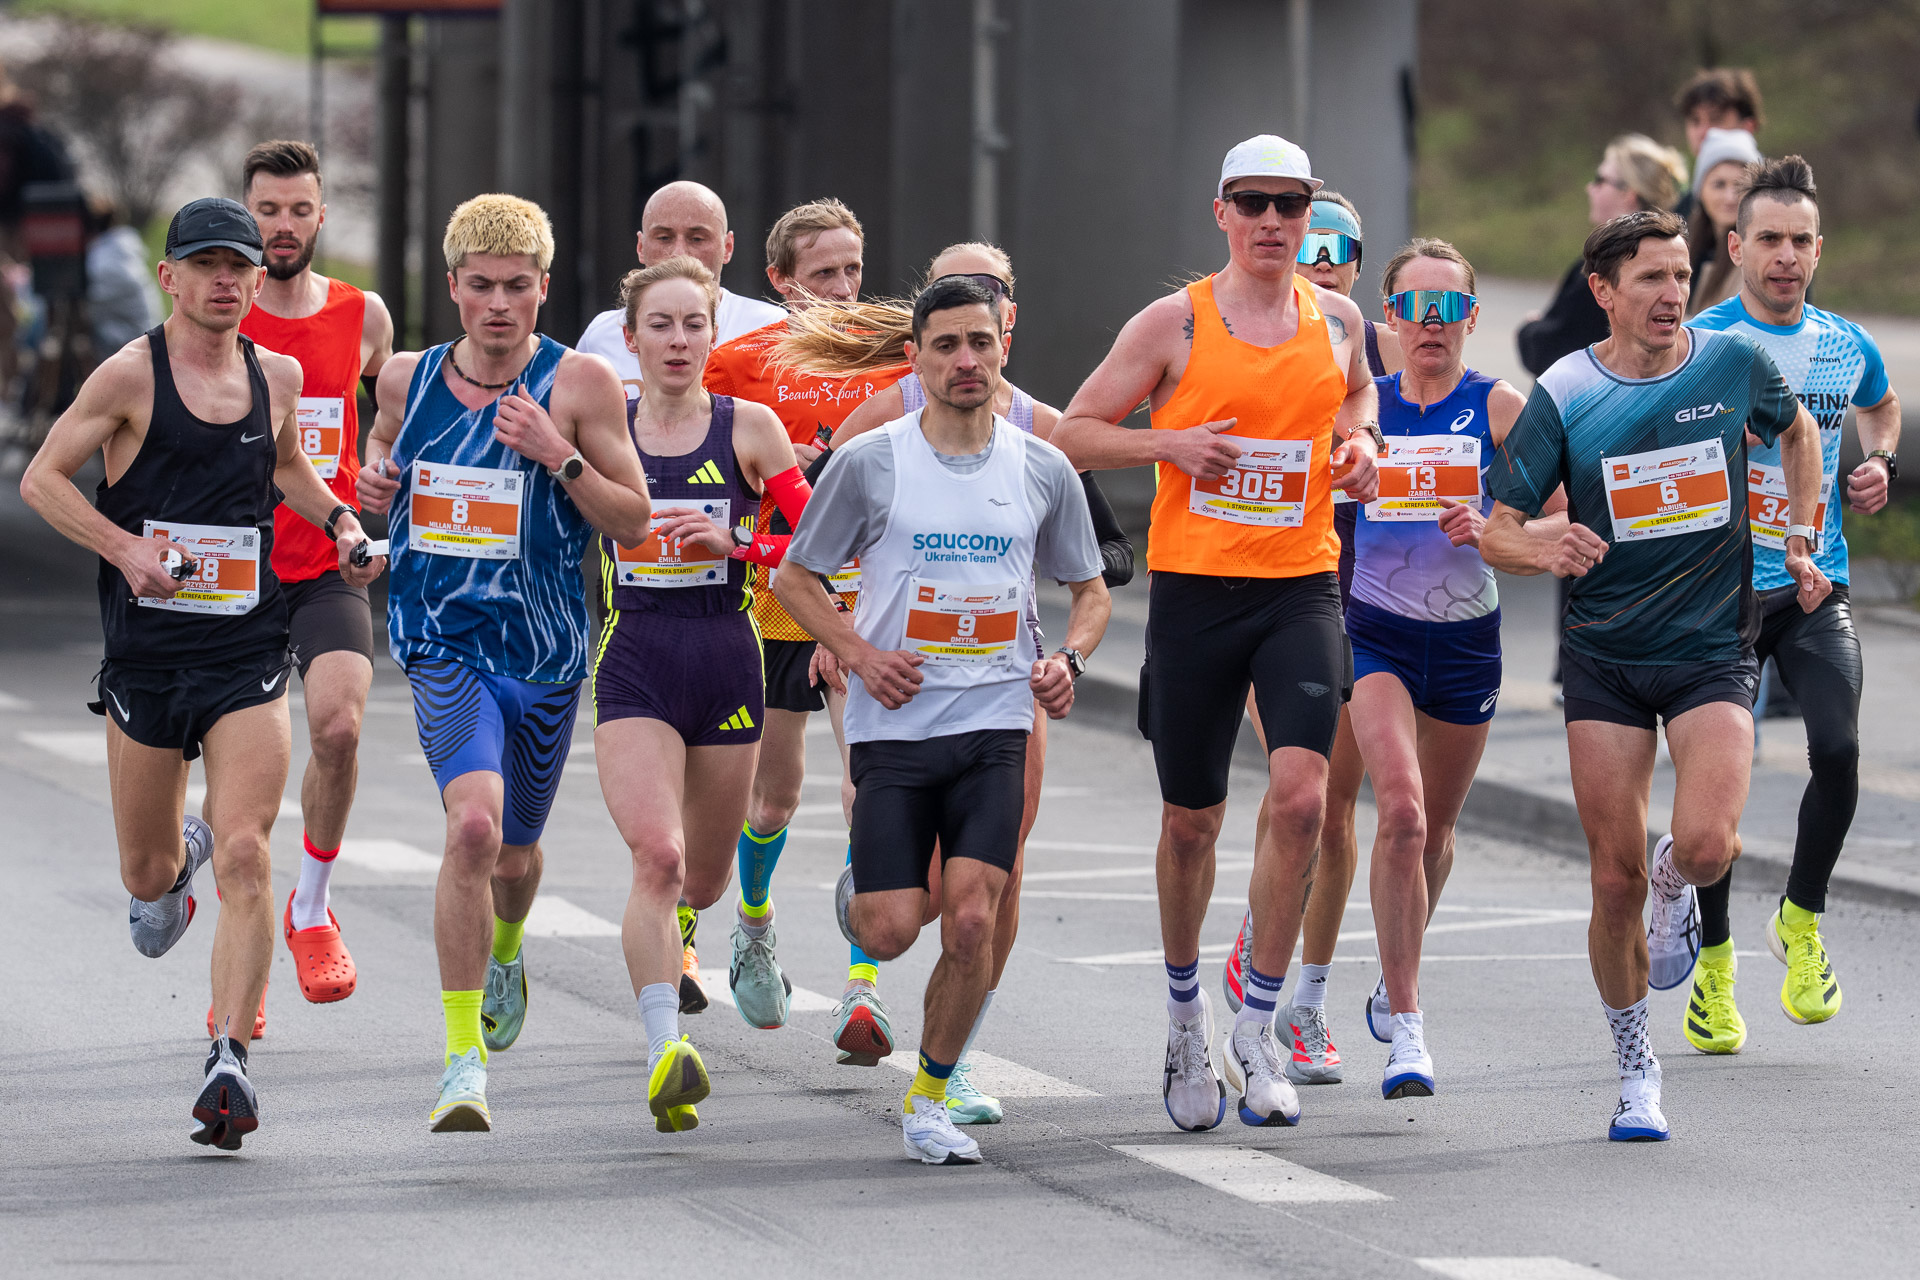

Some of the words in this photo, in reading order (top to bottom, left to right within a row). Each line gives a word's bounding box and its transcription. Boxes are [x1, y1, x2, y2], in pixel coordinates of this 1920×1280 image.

[777, 385, 820, 406] Beauty
[865, 382, 883, 398] Ru
[1795, 393, 1849, 410] RFINA
[1674, 402, 1725, 423] GIZA
[1816, 414, 1842, 430] WA
[299, 429, 322, 454] 8
[1220, 469, 1284, 500] 305
[1406, 466, 1436, 490] 13
[1660, 480, 1679, 504] 6
[451, 500, 468, 524] 8
[1657, 502, 1687, 513] MARIUSZ
[429, 521, 451, 530] MILLAN
[658, 534, 680, 556] 11
[913, 533, 1013, 556] saucony
[186, 581, 219, 589] RZYSZTOF
[957, 615, 976, 637] 9
